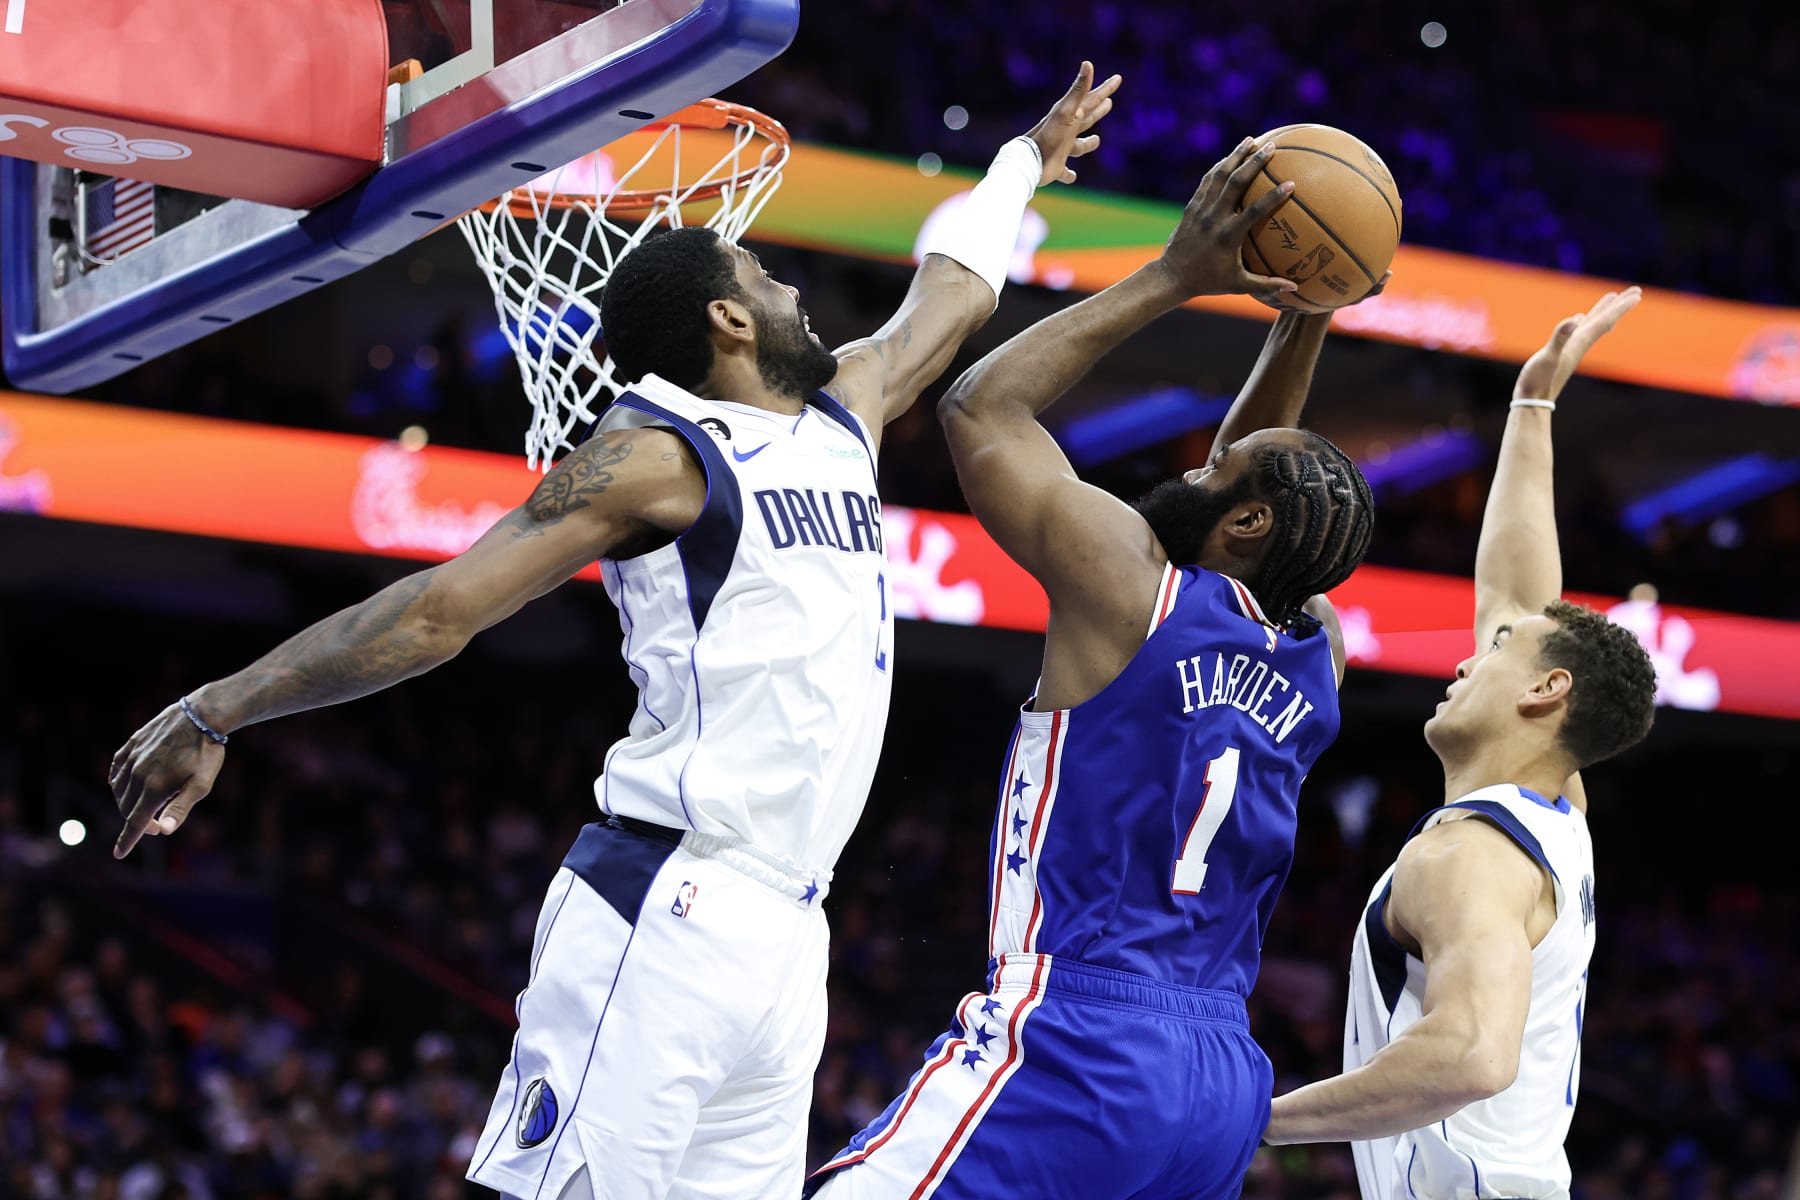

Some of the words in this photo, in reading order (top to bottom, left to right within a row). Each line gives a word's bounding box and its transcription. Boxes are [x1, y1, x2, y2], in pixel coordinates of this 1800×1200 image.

[753, 488, 883, 556] DALLAS
[1176, 653, 1313, 744] HARDEN
[1171, 746, 1241, 896] 1
